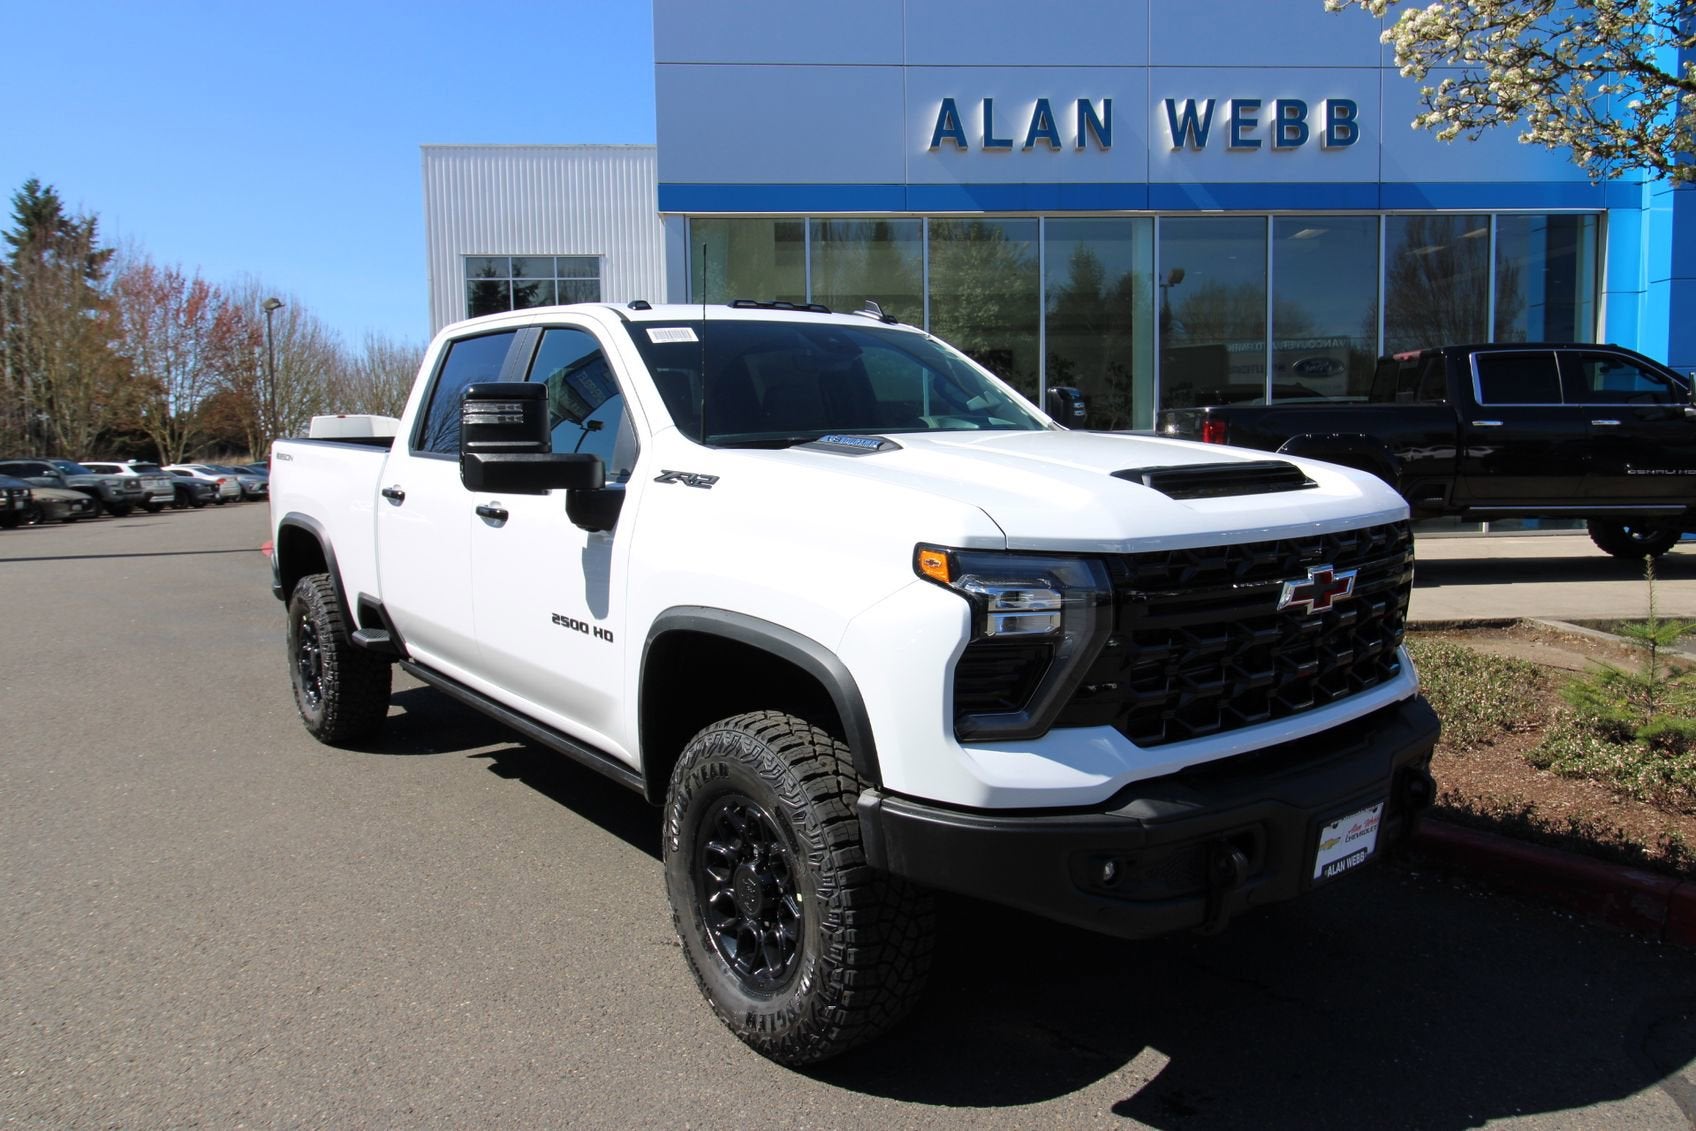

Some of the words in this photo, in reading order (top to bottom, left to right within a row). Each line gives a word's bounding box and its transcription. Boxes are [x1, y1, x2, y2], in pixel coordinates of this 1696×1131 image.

[930, 97, 1112, 151] ALAN
[1164, 98, 1360, 151] WEBB
[654, 469, 720, 490] ZR2
[552, 612, 589, 635] 2500
[593, 626, 614, 643] HD
[1327, 860, 1346, 878] ALAN
[1346, 850, 1365, 869] WEBB
